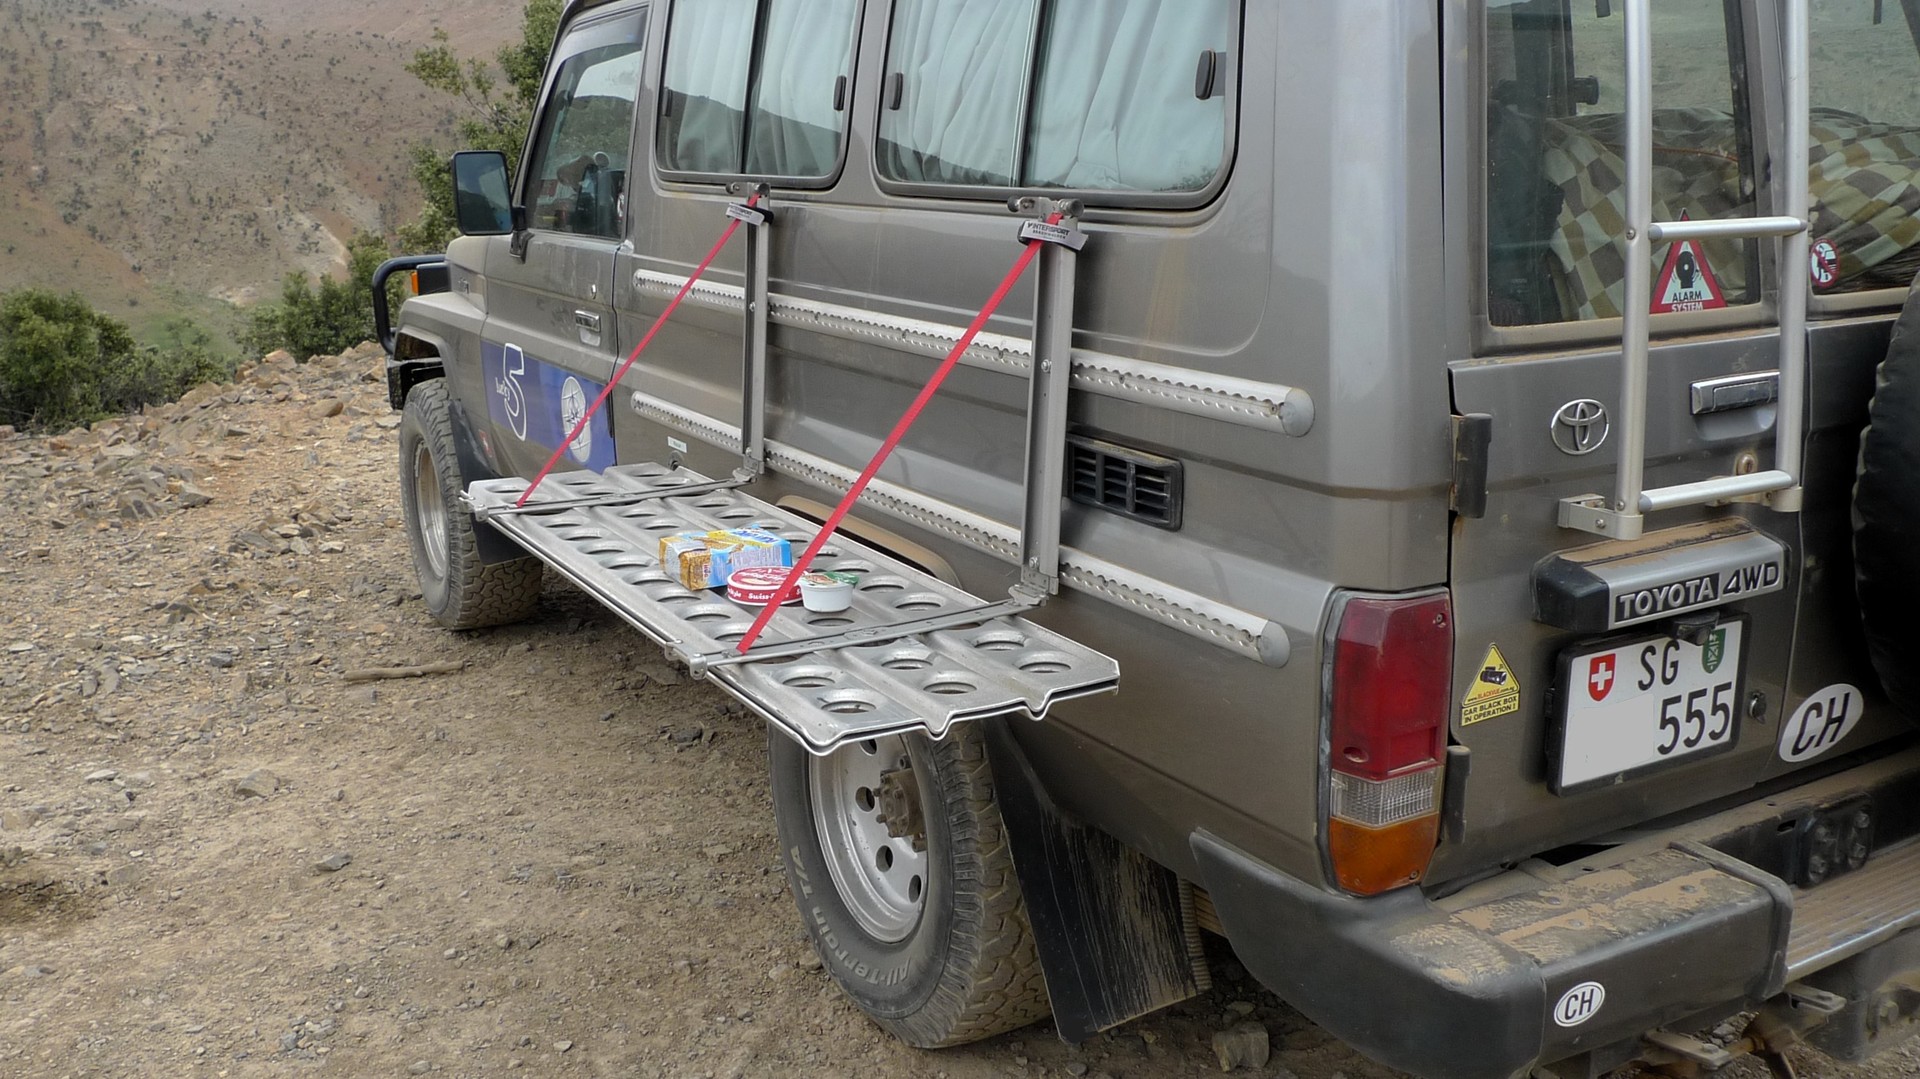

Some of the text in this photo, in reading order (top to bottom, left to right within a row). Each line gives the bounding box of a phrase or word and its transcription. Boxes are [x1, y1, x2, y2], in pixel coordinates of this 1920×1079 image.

[1672, 290, 1702, 303] ALARM
[1672, 302, 1703, 312] SYSTEM
[1618, 561, 1781, 619] TOYOTA 4WD
[1637, 639, 1680, 691] SG
[1463, 695, 1518, 716] CAR BLACK BOX
[1464, 715, 1472, 723] IN
[1473, 704, 1512, 720] OPERATION
[1657, 681, 1733, 756] 555
[1791, 692, 1852, 757] CH
[812, 906, 911, 986] All-Terrain
[1564, 988, 1595, 1021] CH
